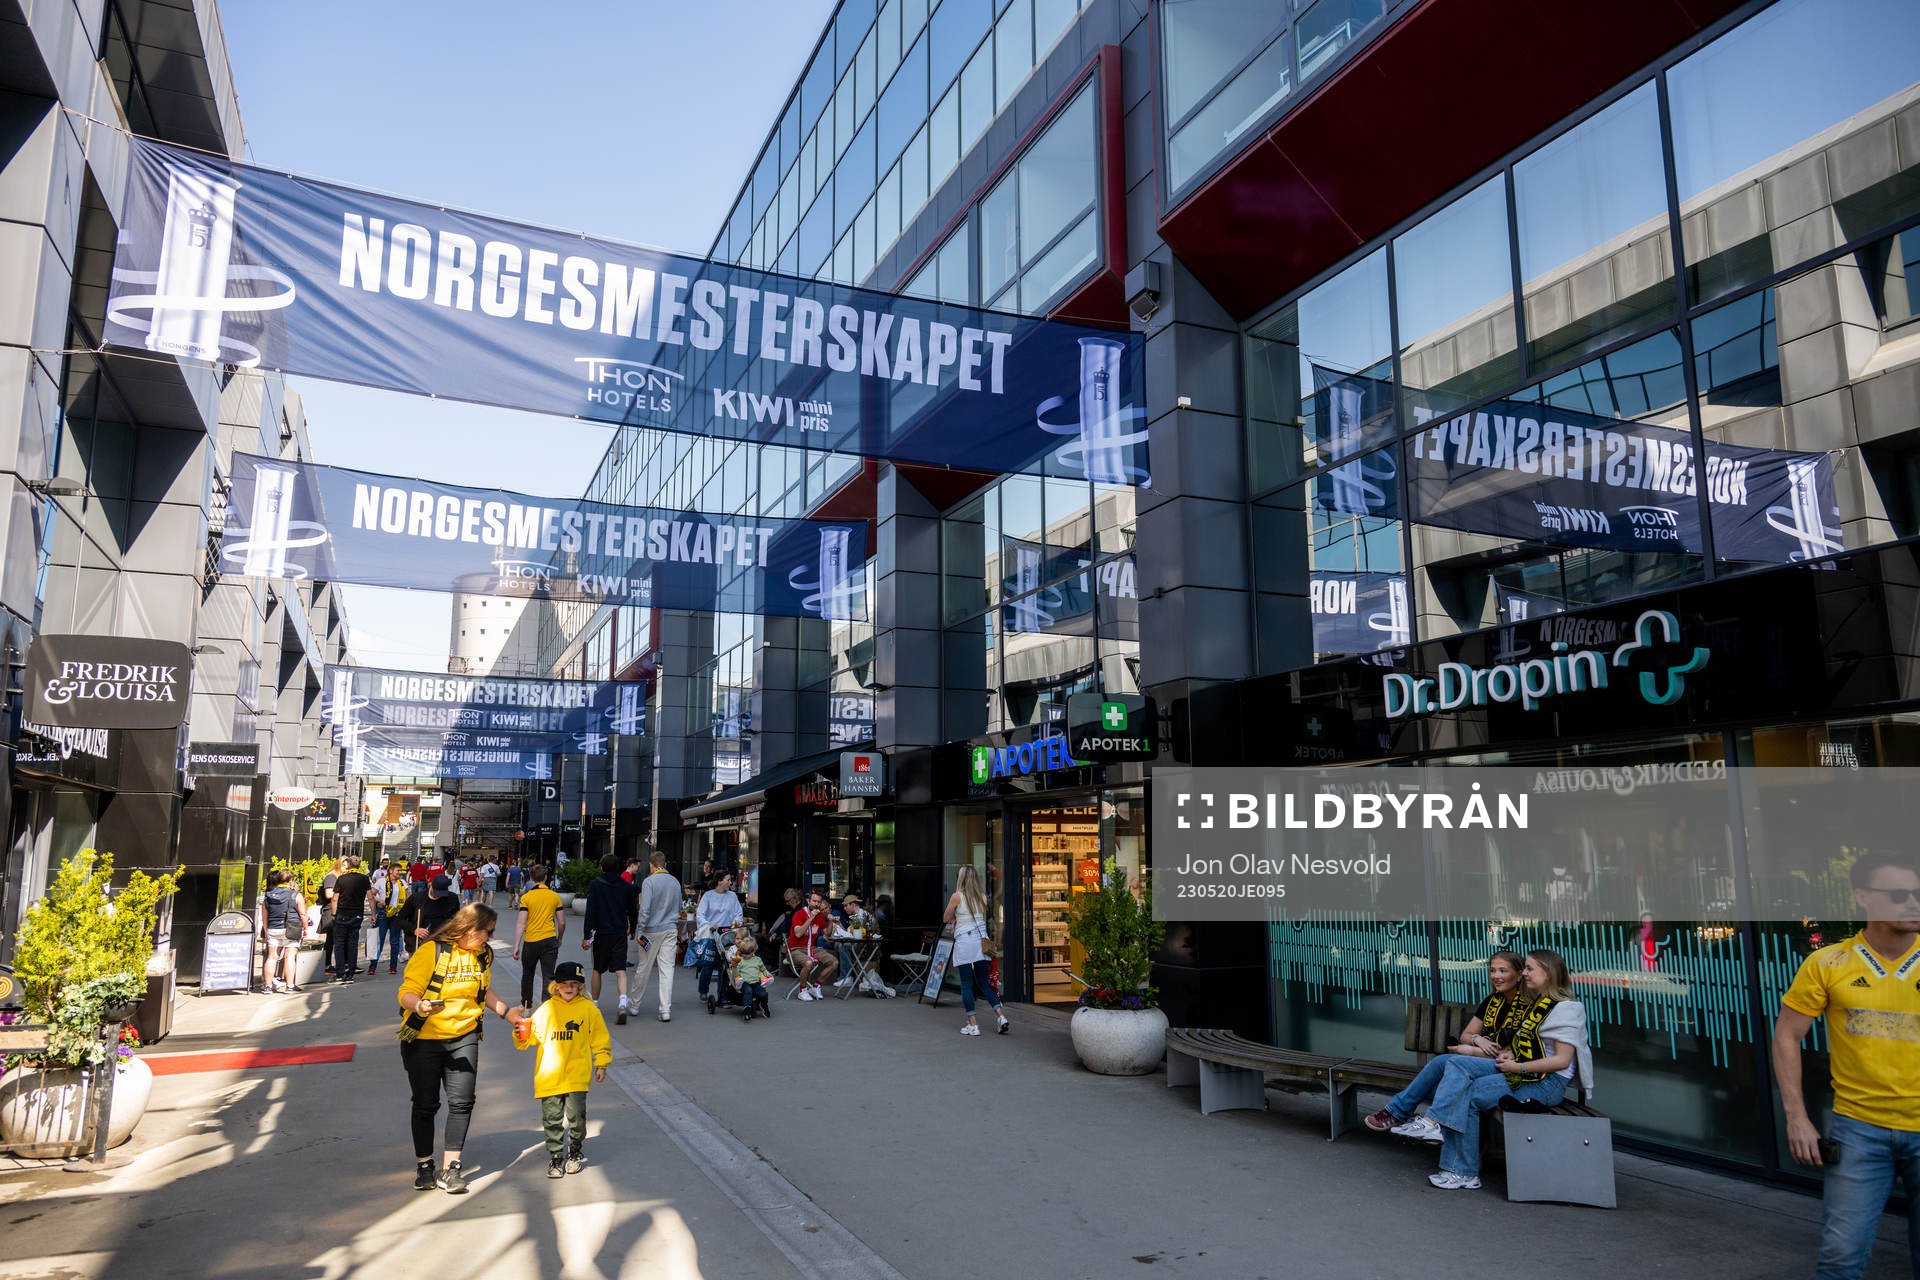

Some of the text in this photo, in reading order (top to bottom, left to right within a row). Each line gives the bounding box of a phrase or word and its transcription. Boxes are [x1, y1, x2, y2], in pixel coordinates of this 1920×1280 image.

[338, 211, 1013, 394] NORGESMESTERSKAPET
[574, 356, 685, 394] THON
[587, 387, 672, 413] HOTELS
[713, 387, 833, 427] KIWI mini
[800, 414, 829, 433] pris
[352, 483, 774, 568] NORGESMESTERSKAPET
[491, 560, 559, 580] THON
[499, 579, 551, 592] HOTELS
[576, 573, 653, 597] KIWI mini
[630, 588, 650, 599] pris
[60, 661, 178, 684] FREDRIK
[1382, 642, 1609, 720] Dr.Dropin
[380, 675, 598, 708] NORGESMESTERSKAPET
[448, 708, 484, 720] THON
[491, 713, 519, 727] KIWI
[452, 718, 480, 726] HOTELS
[476, 735, 499, 747] KIWI
[1080, 737, 1151, 752] APOTEK 1
[190, 754, 255, 764] RENS OG SKOSERVICE
[844, 784, 879, 793] HANSEN
[848, 776, 875, 784] BAKER
[545, 786, 556, 799] D
